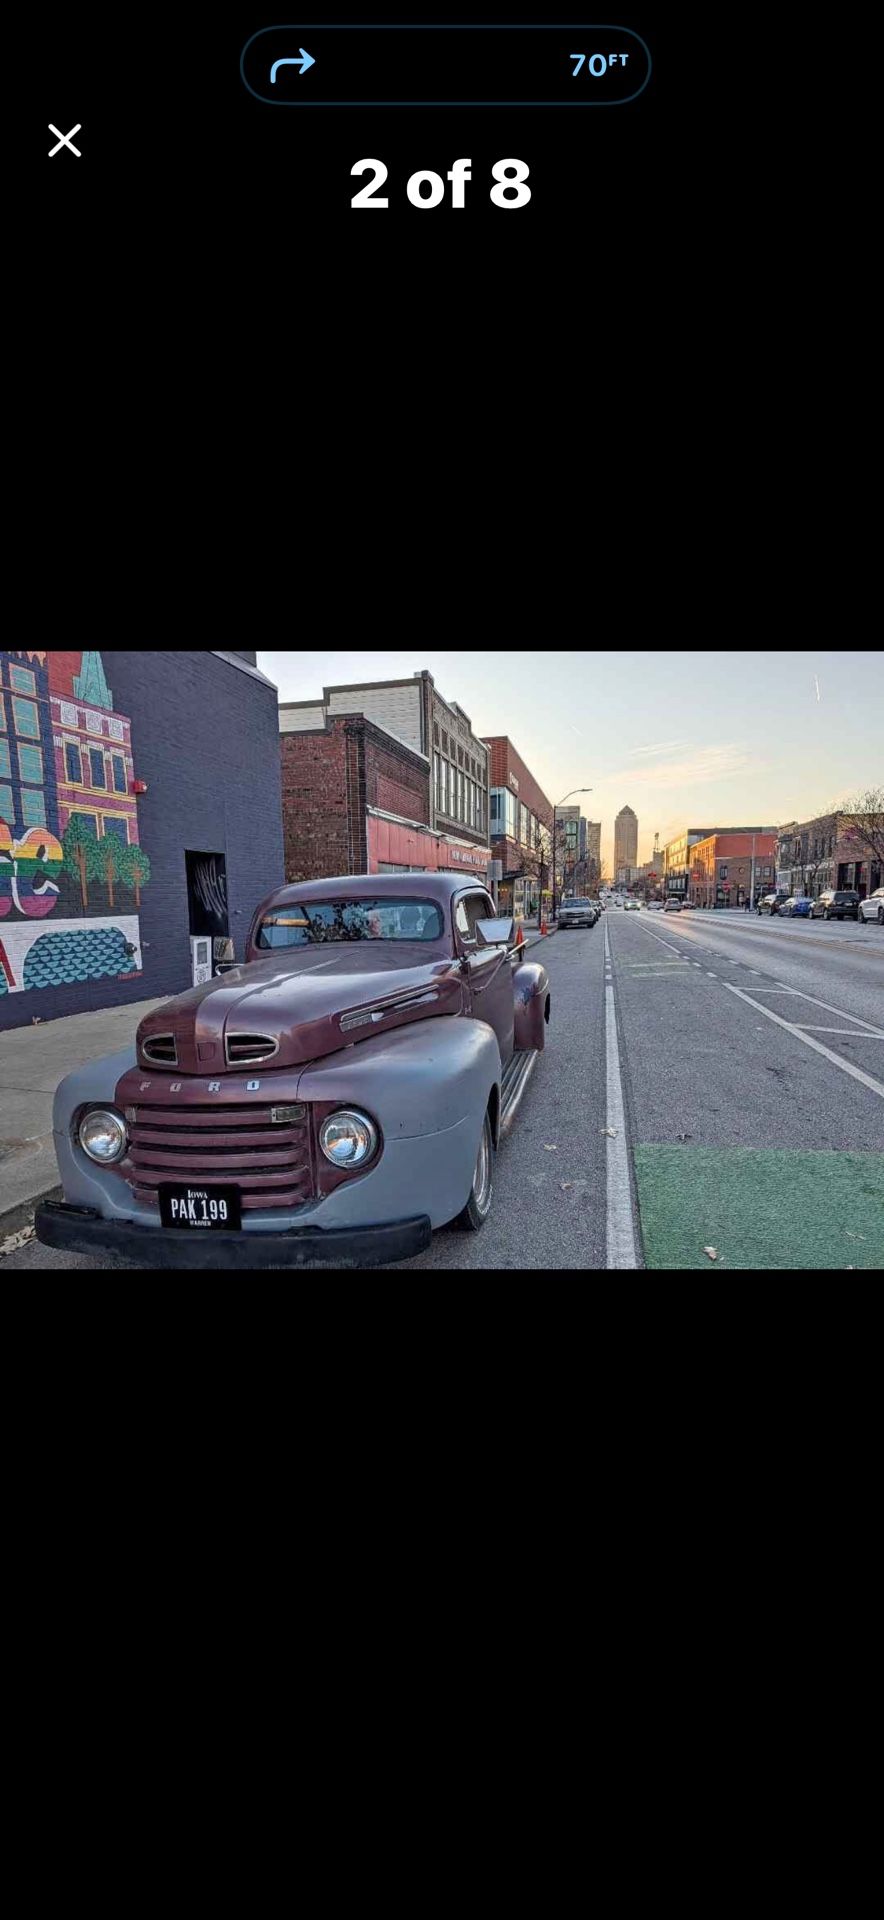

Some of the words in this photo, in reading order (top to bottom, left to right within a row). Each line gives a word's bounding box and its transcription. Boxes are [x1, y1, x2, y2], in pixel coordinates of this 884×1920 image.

[139, 1080, 260, 1092] FORD
[170, 1198, 197, 1219] PAK
[201, 1199, 228, 1220] 199
